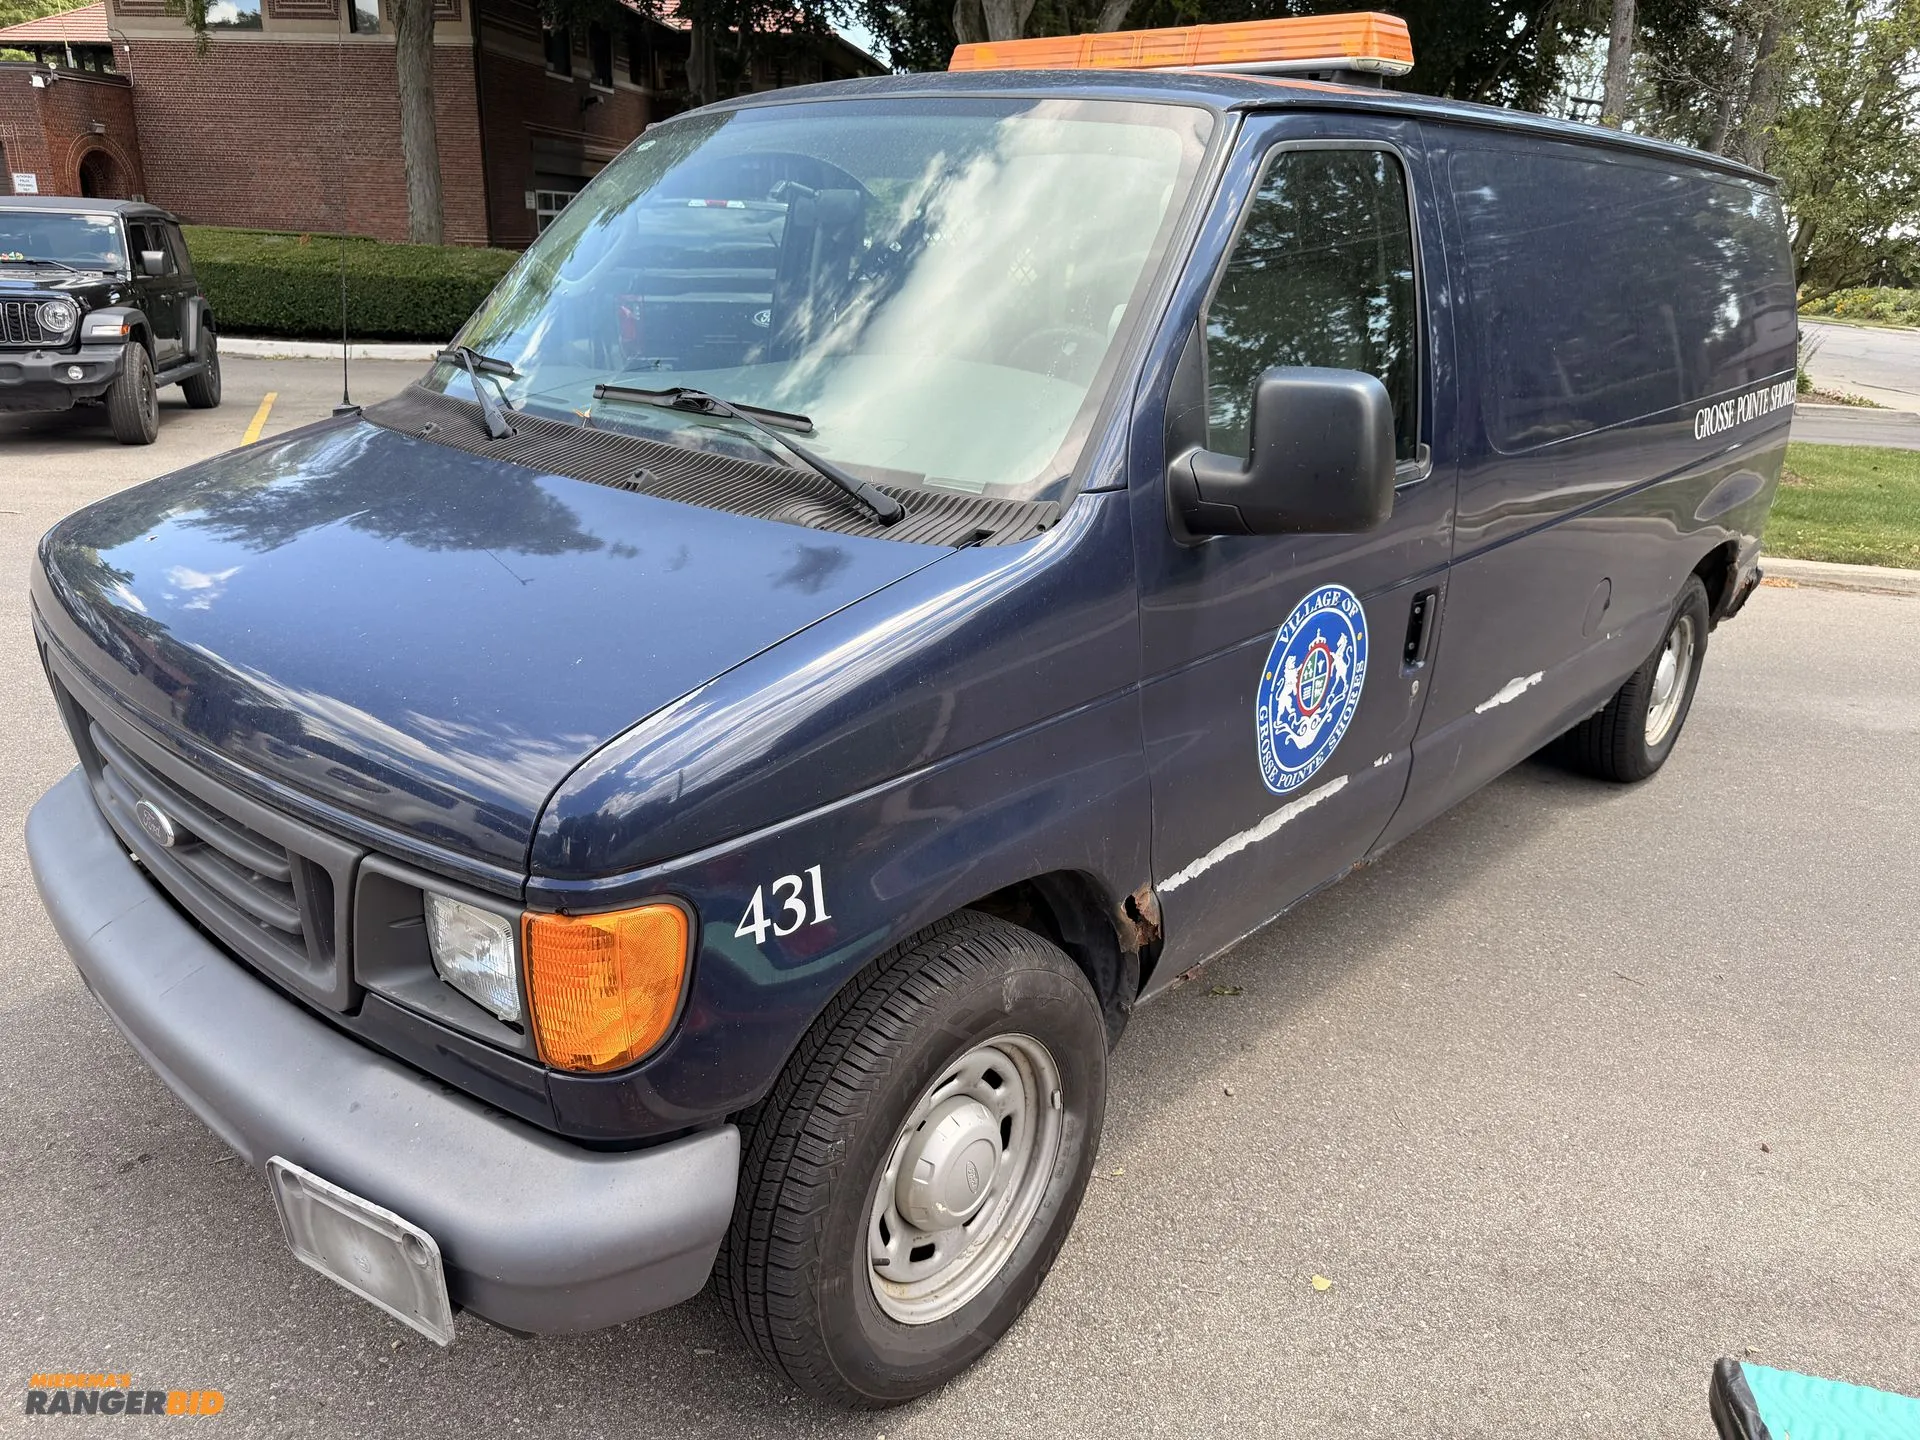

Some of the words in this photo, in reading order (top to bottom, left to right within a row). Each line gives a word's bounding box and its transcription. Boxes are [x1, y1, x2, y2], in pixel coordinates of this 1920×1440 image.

[1694, 399, 1735, 440] GROSSE
[1736, 387, 1770, 425] POINTE
[1279, 591, 1341, 643] VILLAGE
[1341, 598, 1359, 618] OF
[1259, 705, 1279, 782] GROSSE
[1276, 751, 1325, 787] POINTE
[1328, 660, 1365, 750] SHORES
[734, 864, 832, 945] 431
